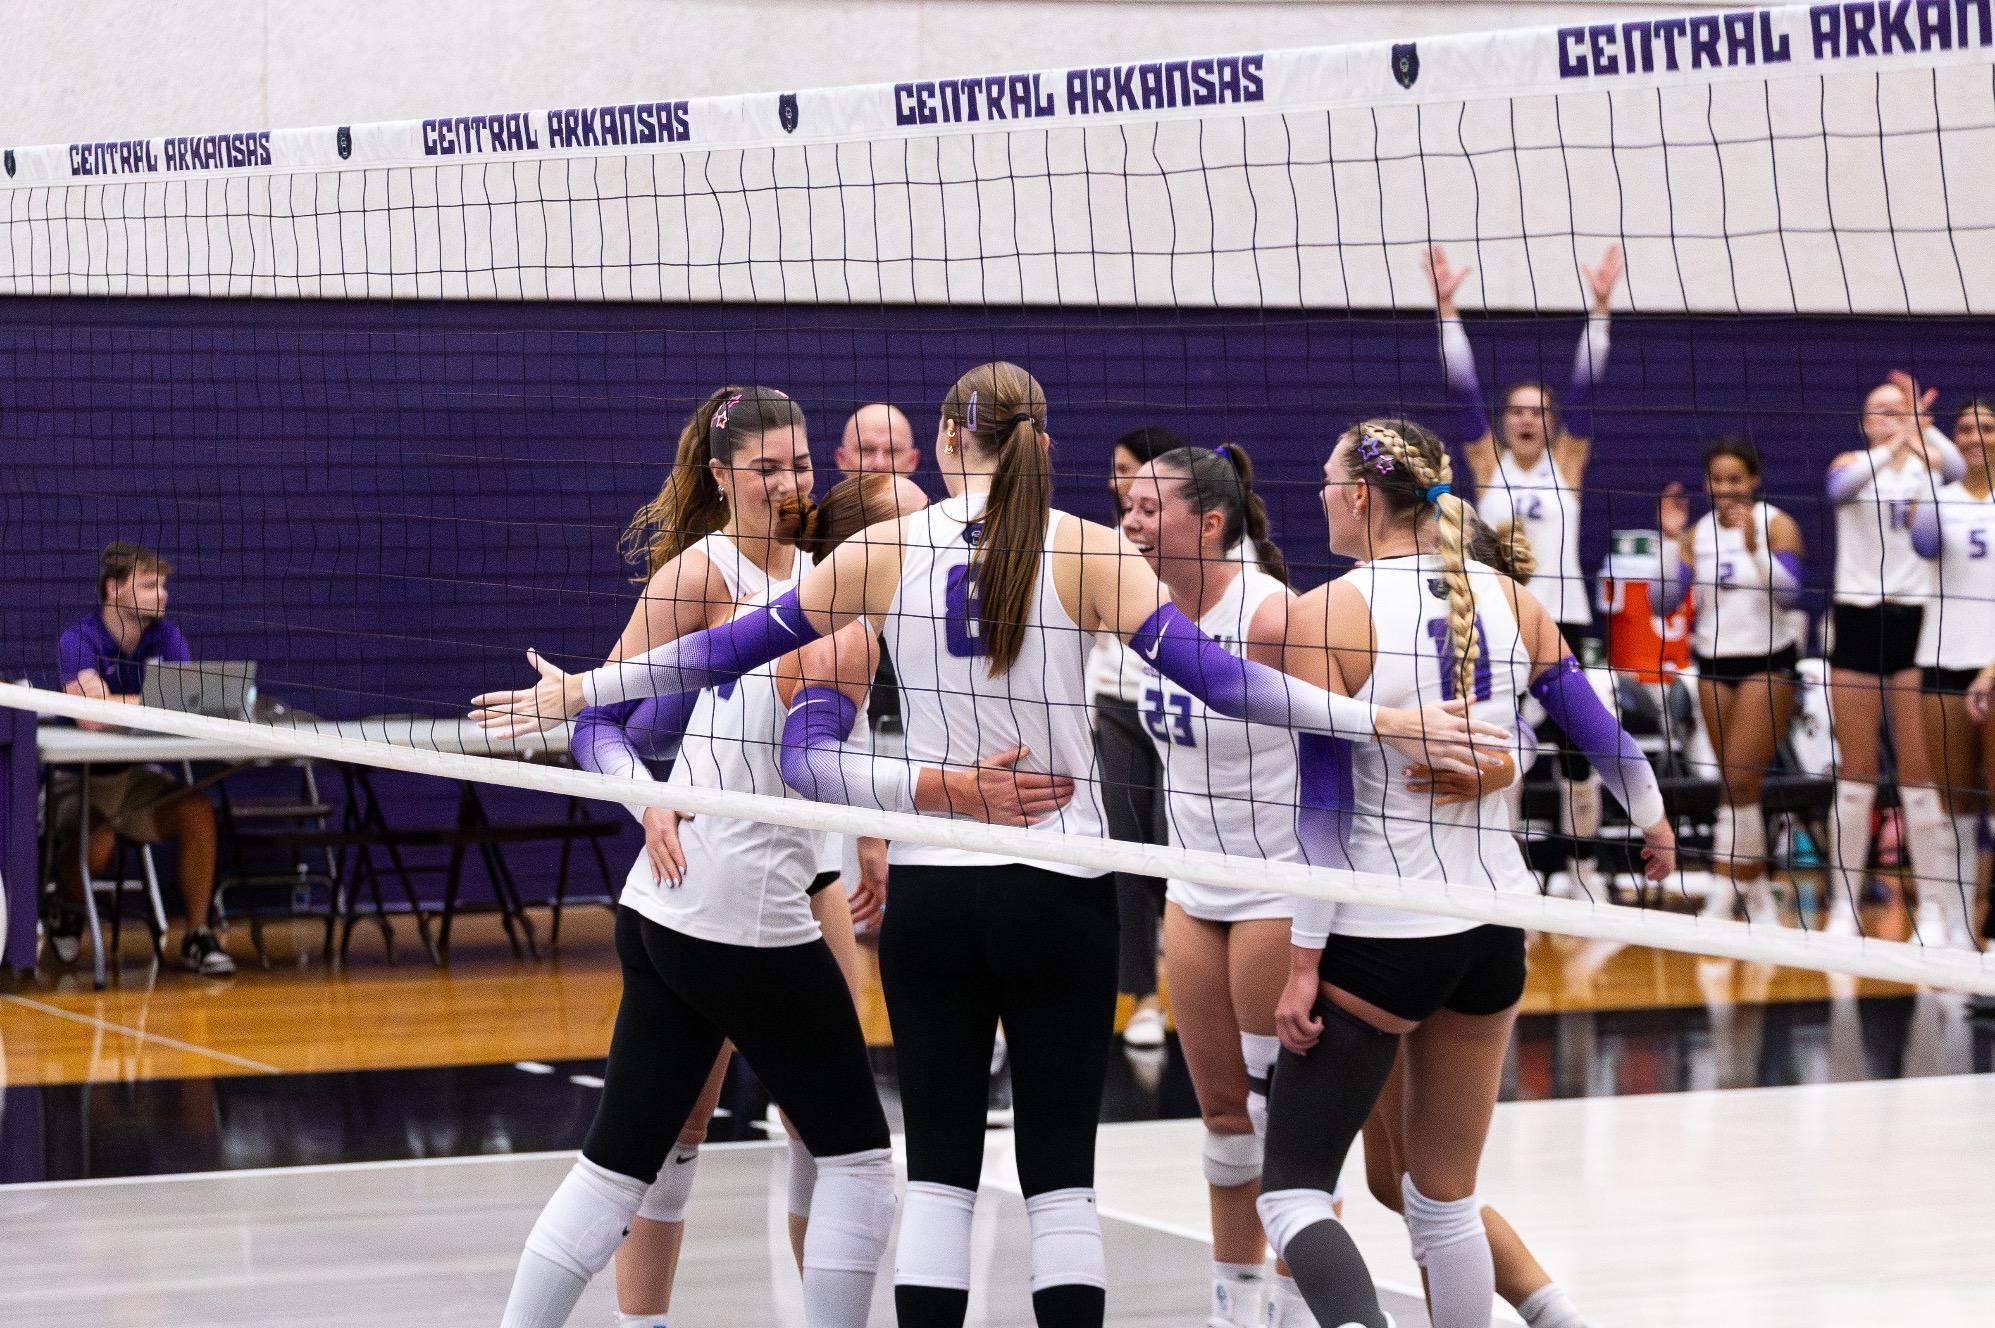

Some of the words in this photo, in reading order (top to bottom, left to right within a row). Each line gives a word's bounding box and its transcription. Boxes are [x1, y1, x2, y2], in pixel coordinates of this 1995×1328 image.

[1557, 10, 1791, 80] CENTRAL
[1809, 0, 1993, 61] ARKAN
[894, 74, 1056, 126] CENTRAL
[1066, 54, 1264, 115] ARKANSAS
[69, 140, 158, 176] CENTRAL
[164, 131, 272, 172] ARKANSAS
[422, 113, 539, 156] CENTRAL
[547, 101, 691, 147] ARKANSAS
[1968, 528, 1988, 559] 5
[1145, 687, 1197, 748] 23
